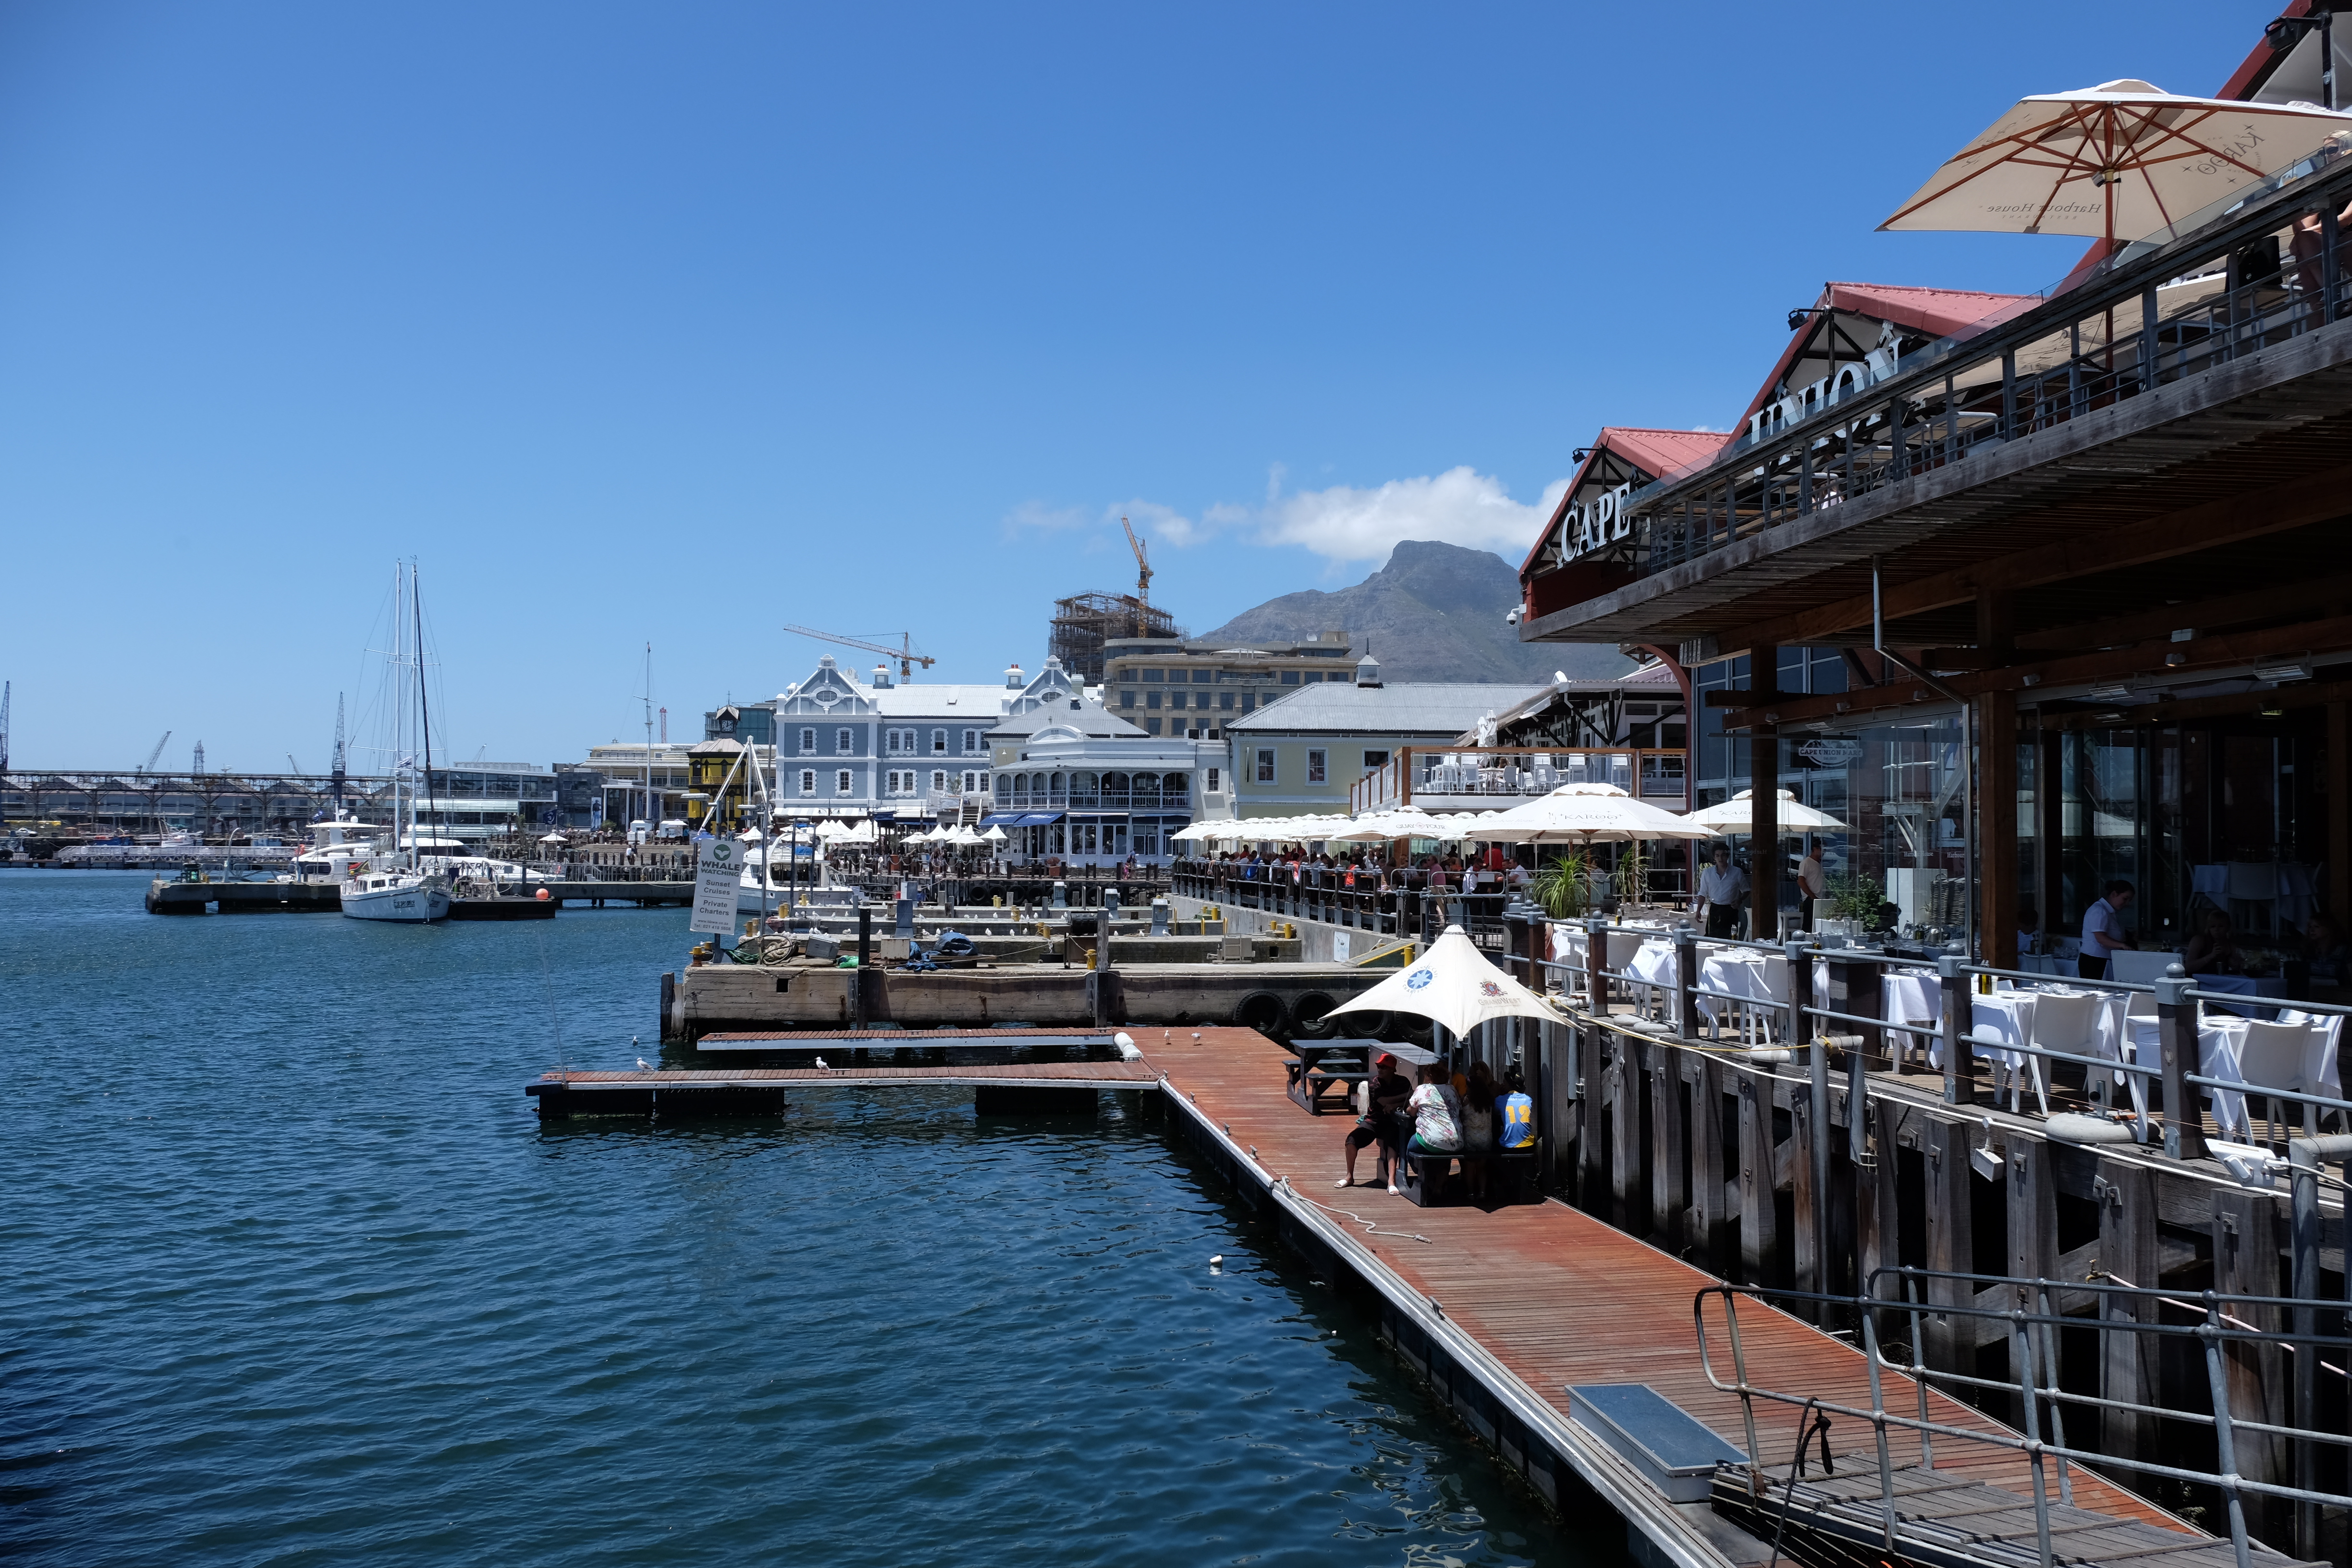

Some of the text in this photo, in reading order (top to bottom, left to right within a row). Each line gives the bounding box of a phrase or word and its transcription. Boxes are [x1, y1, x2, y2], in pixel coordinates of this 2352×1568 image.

[1749, 335, 1906, 476] UNION
[1561, 482, 1630, 562] CAPE
[701, 860, 740, 871] WHALE
[701, 868, 739, 877] WATCHING
[703, 900, 727, 908] Private
[699, 907, 729, 916] Charters
[1506, 1104, 1531, 1124] 12
